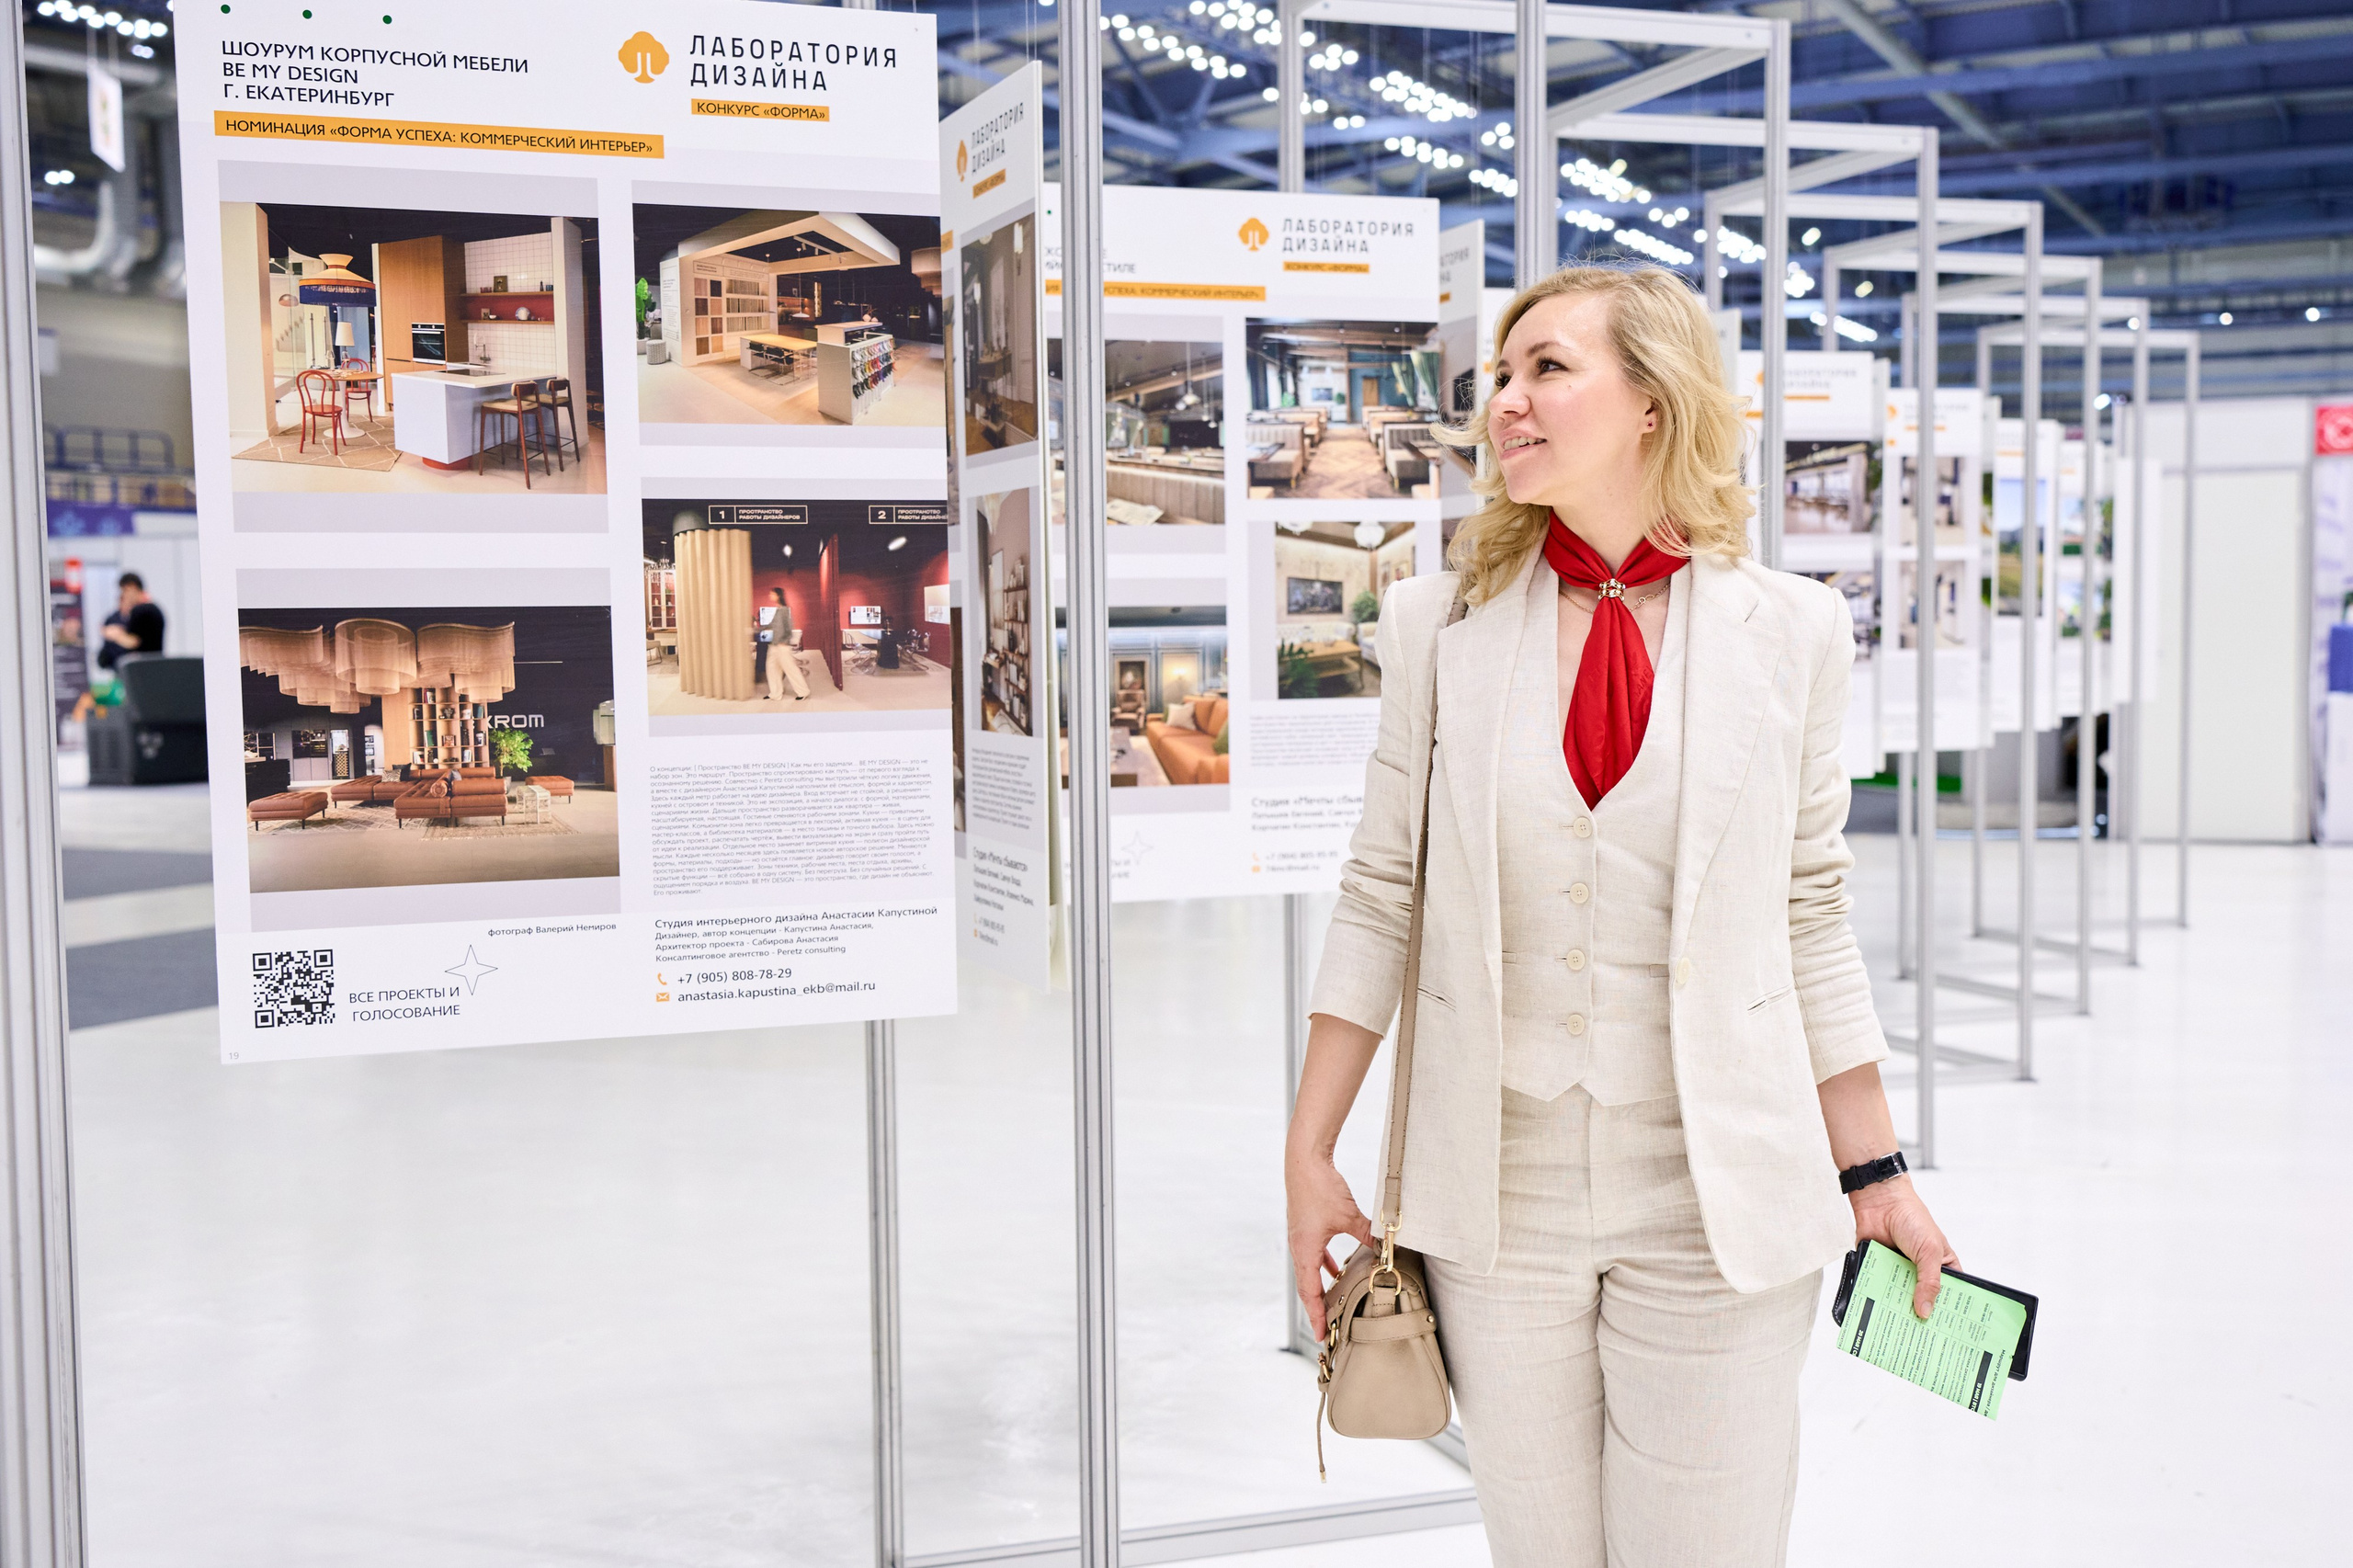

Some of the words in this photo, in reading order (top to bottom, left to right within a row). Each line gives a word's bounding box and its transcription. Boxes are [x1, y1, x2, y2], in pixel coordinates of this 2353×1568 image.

[222, 40, 313, 60] ШОУРУМ
[320, 46, 447, 68] КОРПУСНОЙ
[452, 54, 528, 74] МЕБЕЛИ
[688, 34, 896, 68] ЛАБОРАТОРИЯ
[222, 61, 245, 77] BE
[251, 62, 281, 79] MY
[287, 64, 358, 84] DESIGN
[689, 62, 827, 91] ДИЗАЙНА
[223, 83, 239, 98] Г.
[245, 84, 394, 107] ЕКАТЕРИНБУРГ
[696, 101, 760, 117] КОНКУРС
[762, 106, 825, 119] «ФОРМА»
[972, 102, 1024, 150] ЛАБОРАТОРИЯ
[225, 119, 325, 137] НОМИНАЦИЯ
[329, 125, 392, 140] «ФОРМА
[395, 128, 456, 142] УСПЕХА:
[460, 131, 575, 149] КОММЕРЧЕСКИЙ
[579, 138, 653, 153] ИНТЕРЬЕР»
[972, 138, 1006, 175] ДИЗАЙНА
[1282, 219, 1415, 236] ЛАБОРАТОРИЯ
[1282, 234, 1369, 253] ДИЗАЙНА
[719, 510, 725, 519] 1
[878, 510, 886, 519] 2
[697, 763, 742, 771] Пространство
[728, 769, 772, 778] Пространство
[758, 783, 794, 791] Капустиной
[654, 918, 693, 929] Студия
[695, 915, 772, 927] интерьерного
[774, 913, 818, 924] дизайна
[820, 910, 875, 920] Анастасии
[877, 906, 938, 918] Капустиной
[487, 926, 533, 937] фотограф
[535, 925, 574, 934] Валерий
[575, 923, 617, 931] Немиров
[654, 931, 699, 941] Дизайнер,
[701, 929, 728, 937] автор
[729, 927, 777, 936] концепции
[783, 925, 827, 934] Капустина
[828, 923, 874, 931] Анастасия,
[654, 942, 707, 952] Архитектор
[708, 940, 745, 949] проекта
[751, 937, 794, 946] Сабирова
[795, 935, 839, 944] Анастасия
[654, 952, 726, 962] Консалтинговое
[728, 949, 770, 959] агентство
[776, 948, 802, 956] Peretz
[803, 945, 847, 954] consulting
[676, 972, 692, 983] +7
[696, 971, 728, 984] (905)
[731, 967, 792, 982] 808-78-29
[348, 991, 374, 1004] ВСЕ
[378, 986, 445, 1002] ПРОЕКТЫ
[449, 985, 460, 997] И
[676, 981, 876, 1002] anastasia.kapustina_ekb@mail.ru
[352, 1004, 460, 1022] ГОЛОСОВАНИЕ
[228, 1051, 240, 1061] 19
